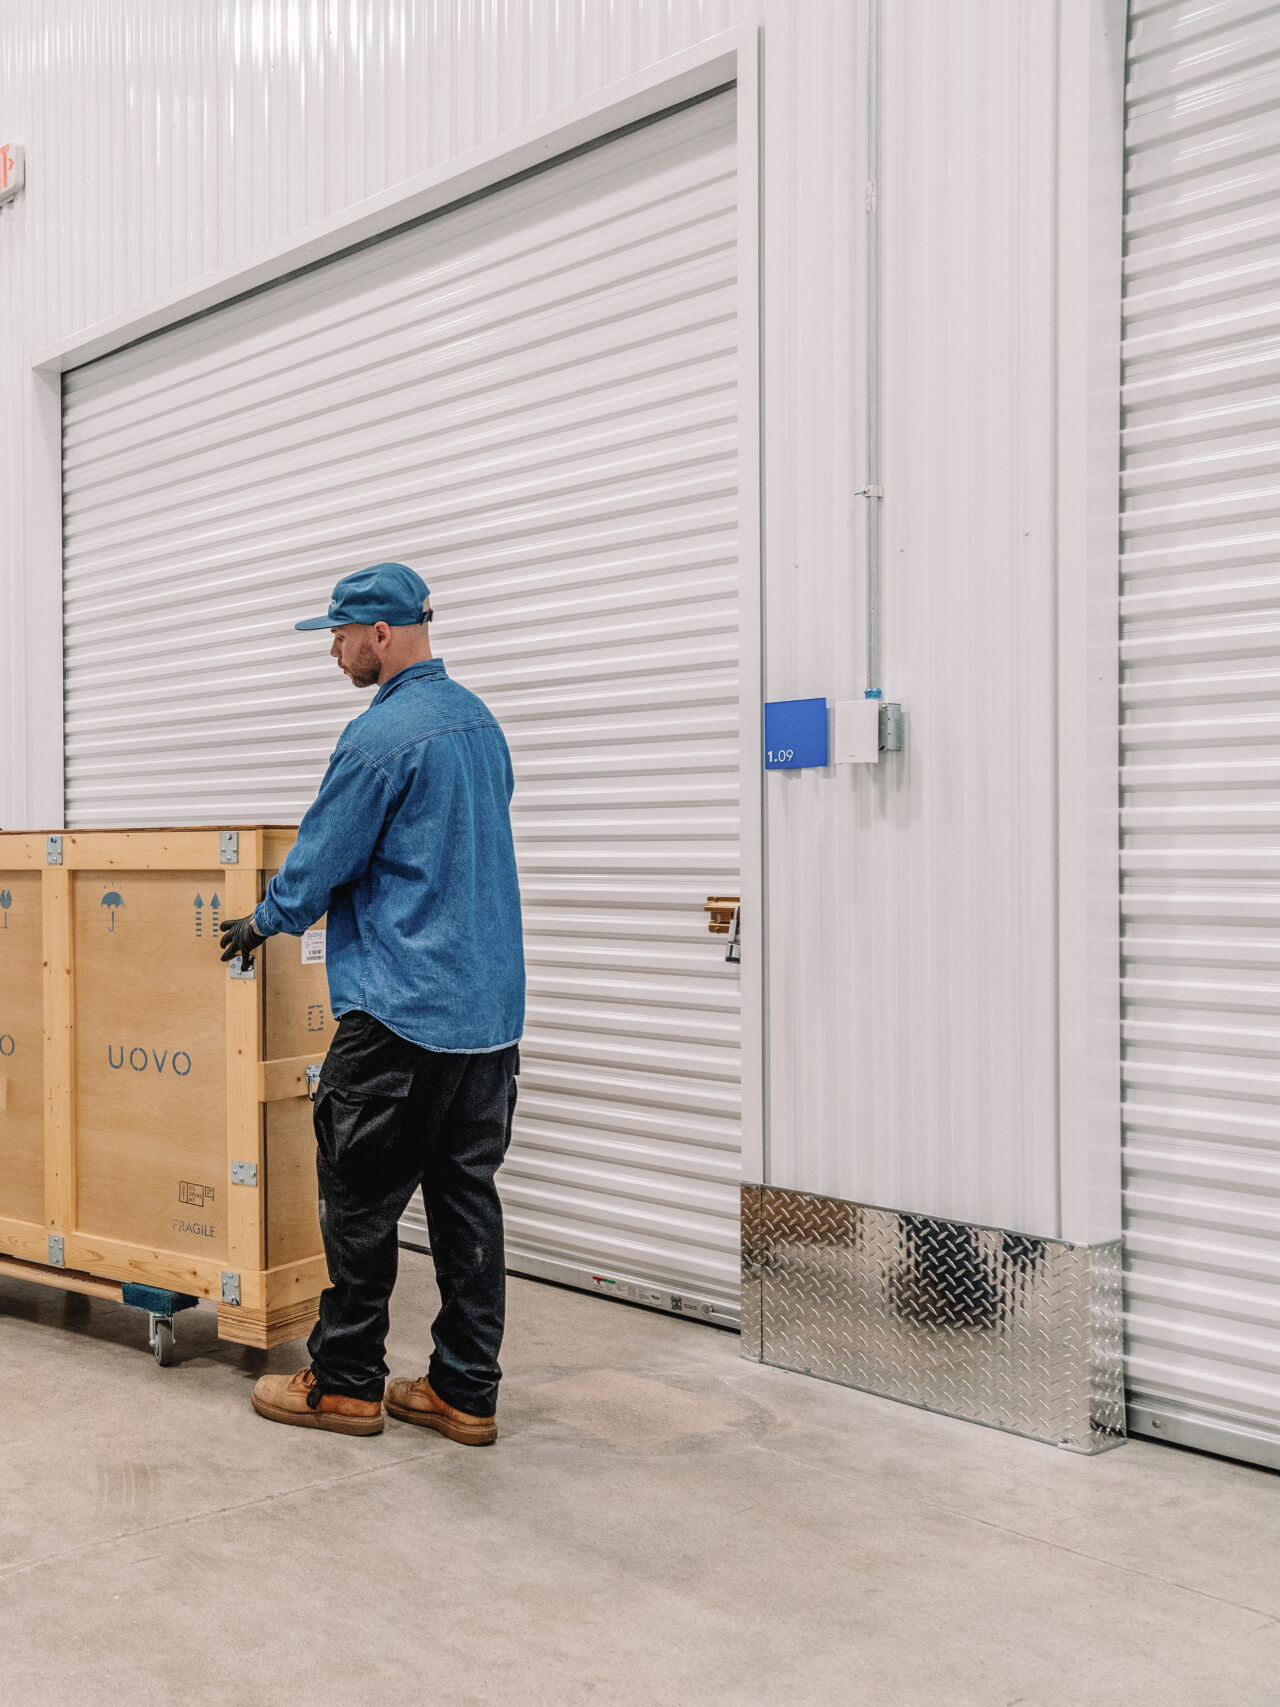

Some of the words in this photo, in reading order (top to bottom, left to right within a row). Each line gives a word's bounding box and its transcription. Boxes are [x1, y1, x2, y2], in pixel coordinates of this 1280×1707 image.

[767, 749, 794, 763] 1.09
[108, 1044, 192, 1076] UOVO
[173, 1219, 216, 1238] FRAGILE
